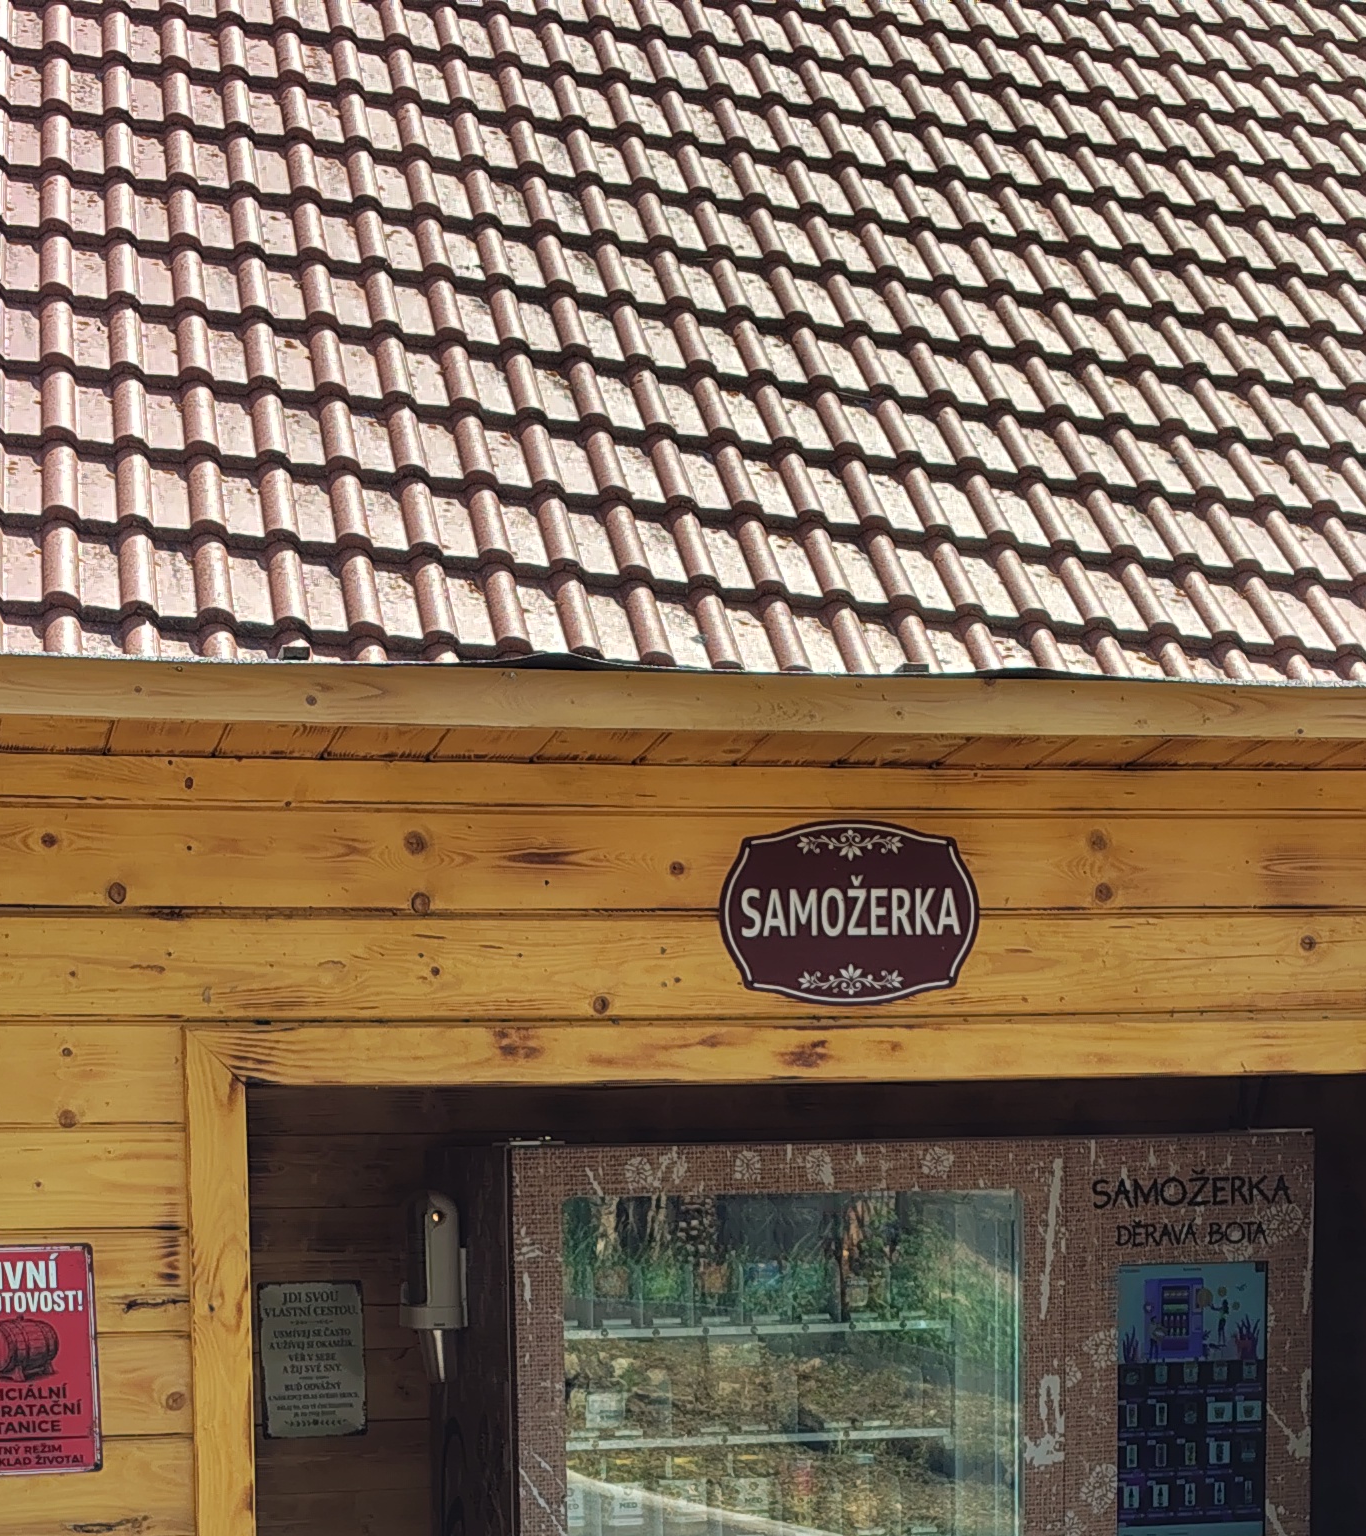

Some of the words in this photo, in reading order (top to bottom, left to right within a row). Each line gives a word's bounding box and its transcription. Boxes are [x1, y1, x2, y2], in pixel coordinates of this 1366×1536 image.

[740, 874, 962, 938] SAMOŽERKA
[1091, 1168, 1296, 1210] SAMOŽERKA
[1115, 1217, 1199, 1247] DĚRAVÁ
[1208, 1221, 1269, 1245] BOTA
[282, 1292, 302, 1305] JDI
[305, 1290, 339, 1303] SVOU
[263, 1304, 311, 1318] VLASTNÍ
[23, 1442, 63, 1455] REŽIM
